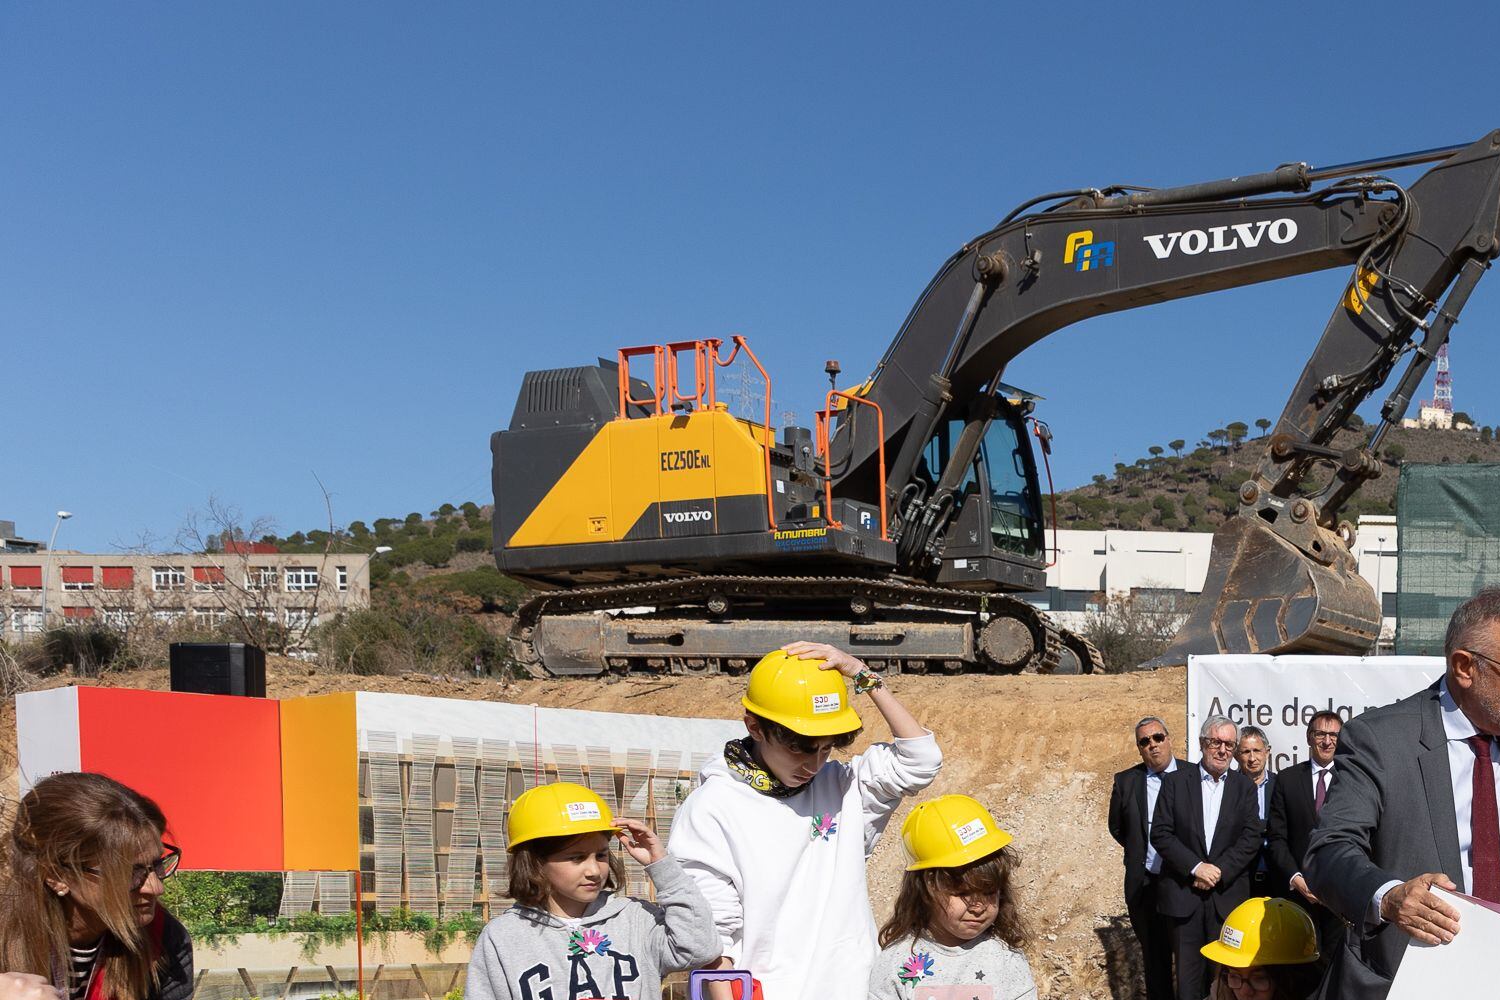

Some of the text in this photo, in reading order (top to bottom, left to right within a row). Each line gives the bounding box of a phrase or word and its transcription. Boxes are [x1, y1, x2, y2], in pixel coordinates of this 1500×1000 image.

[1143, 218, 1297, 259] VOLVO
[664, 510, 712, 522] VOLVO
[1206, 696, 1273, 726] Acte
[1282, 697, 1322, 726] de
